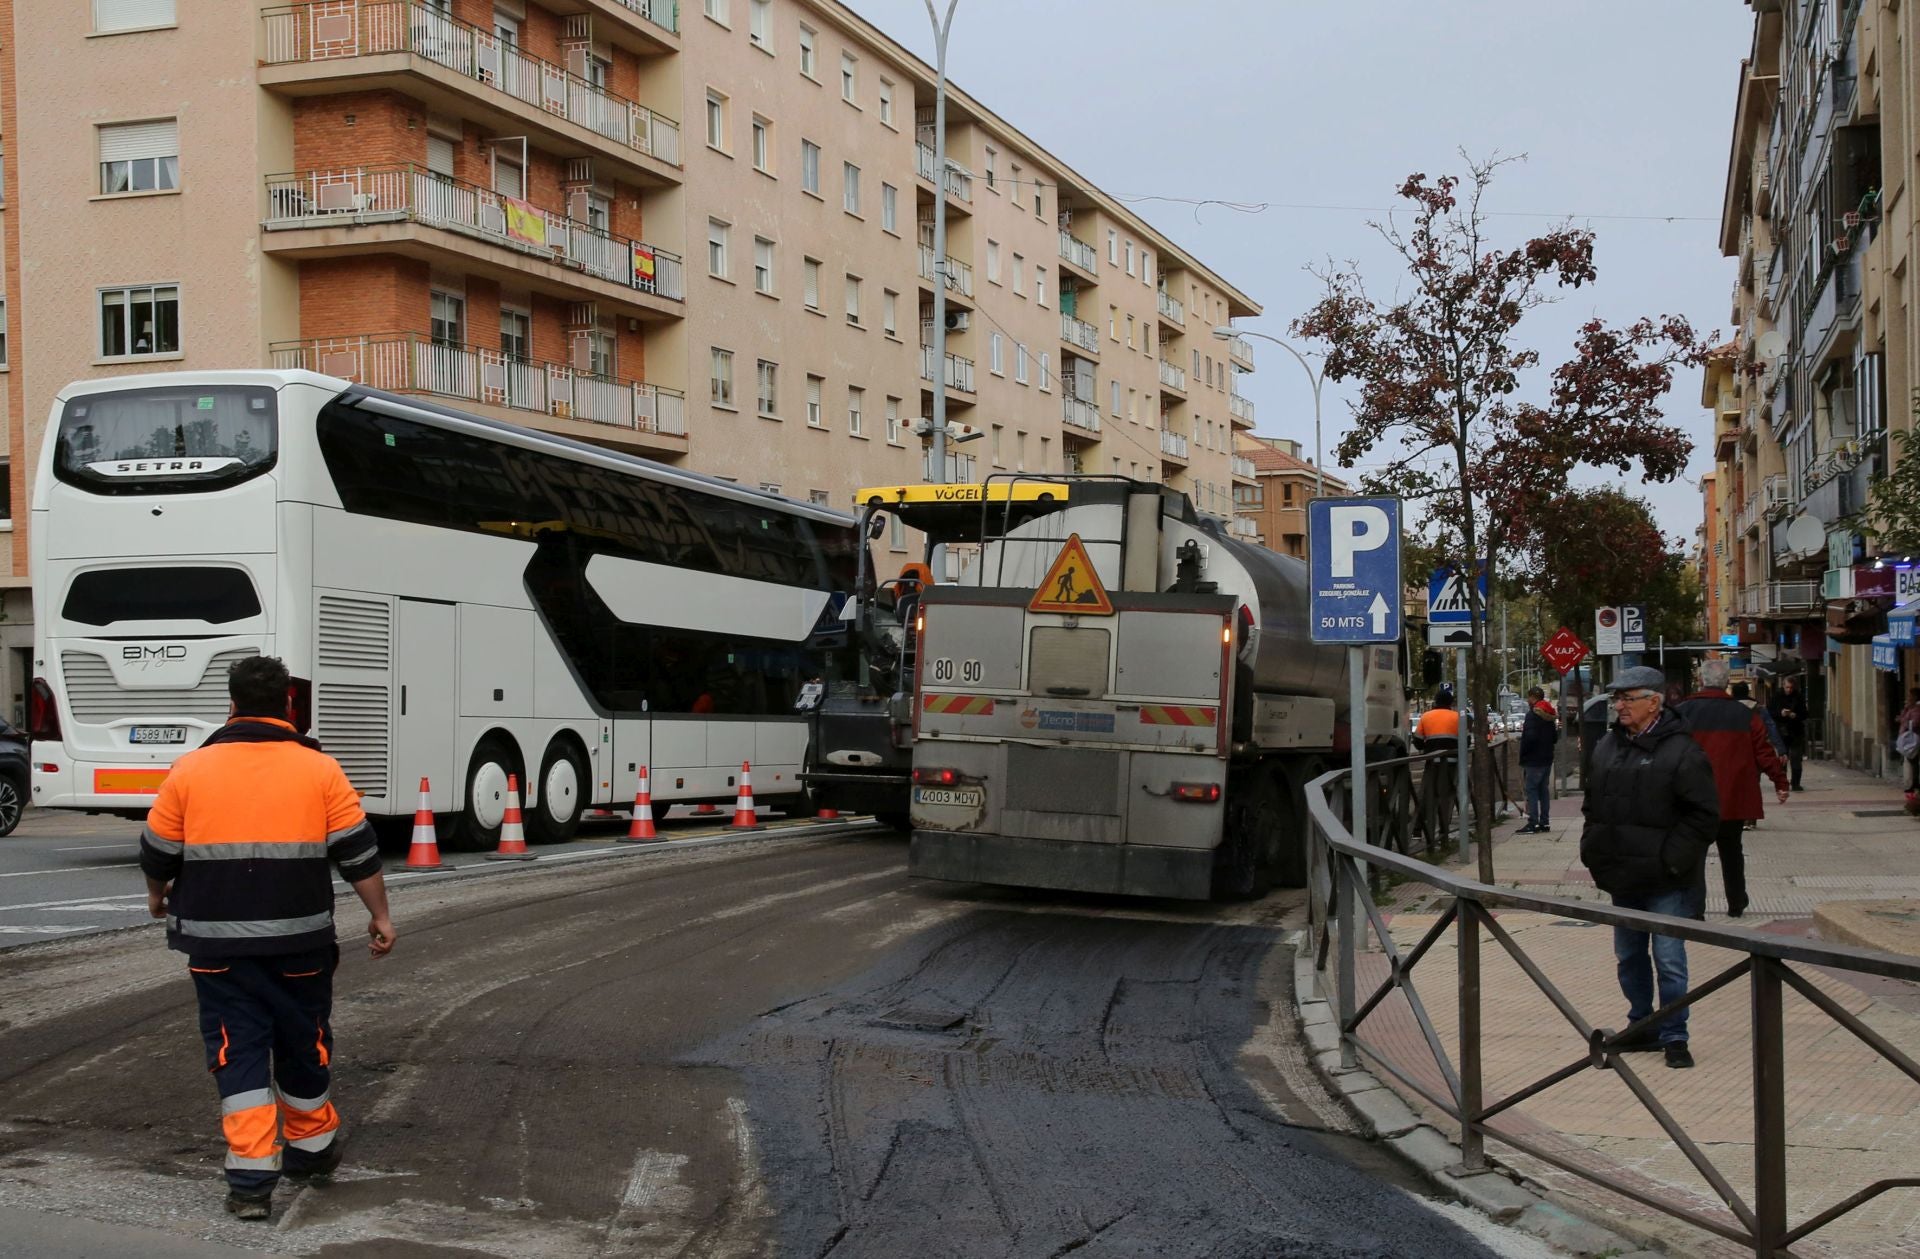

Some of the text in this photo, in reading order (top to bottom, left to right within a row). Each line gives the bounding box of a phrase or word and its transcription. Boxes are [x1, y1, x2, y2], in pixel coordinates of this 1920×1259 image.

[117, 462, 202, 472] SETRA
[1330, 506, 1390, 577] P
[1321, 617, 1364, 628] 50 MTS
[1623, 607, 1639, 632] P
[123, 645, 187, 659] BMD
[936, 660, 981, 681] 80 90
[1043, 713, 1074, 725] Tecno
[136, 729, 160, 739] 5589
[922, 790, 950, 803] 4003
